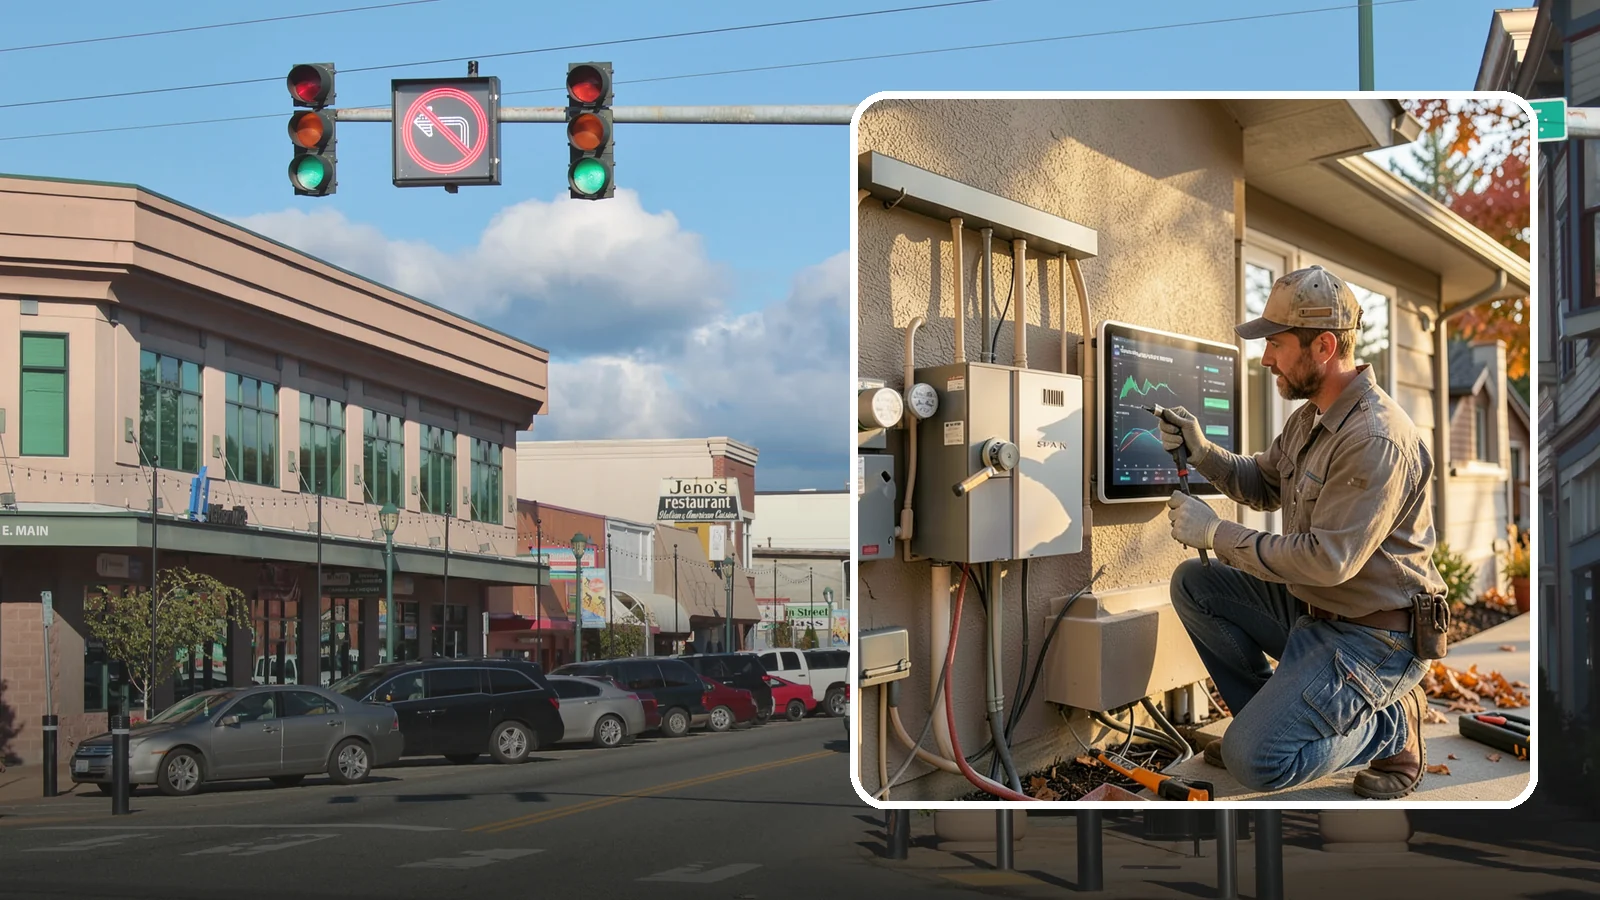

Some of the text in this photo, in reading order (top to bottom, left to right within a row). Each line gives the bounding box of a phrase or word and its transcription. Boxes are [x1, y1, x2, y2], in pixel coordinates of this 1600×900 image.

[669, 479, 728, 494] Jeno's
[664, 496, 731, 509] restaurant
[658, 509, 682, 520] Italian
[685, 509, 714, 520] American
[714, 509, 737, 520] Cuisine
[2, 525, 49, 536] E. MAIN
[797, 607, 829, 617] Street
